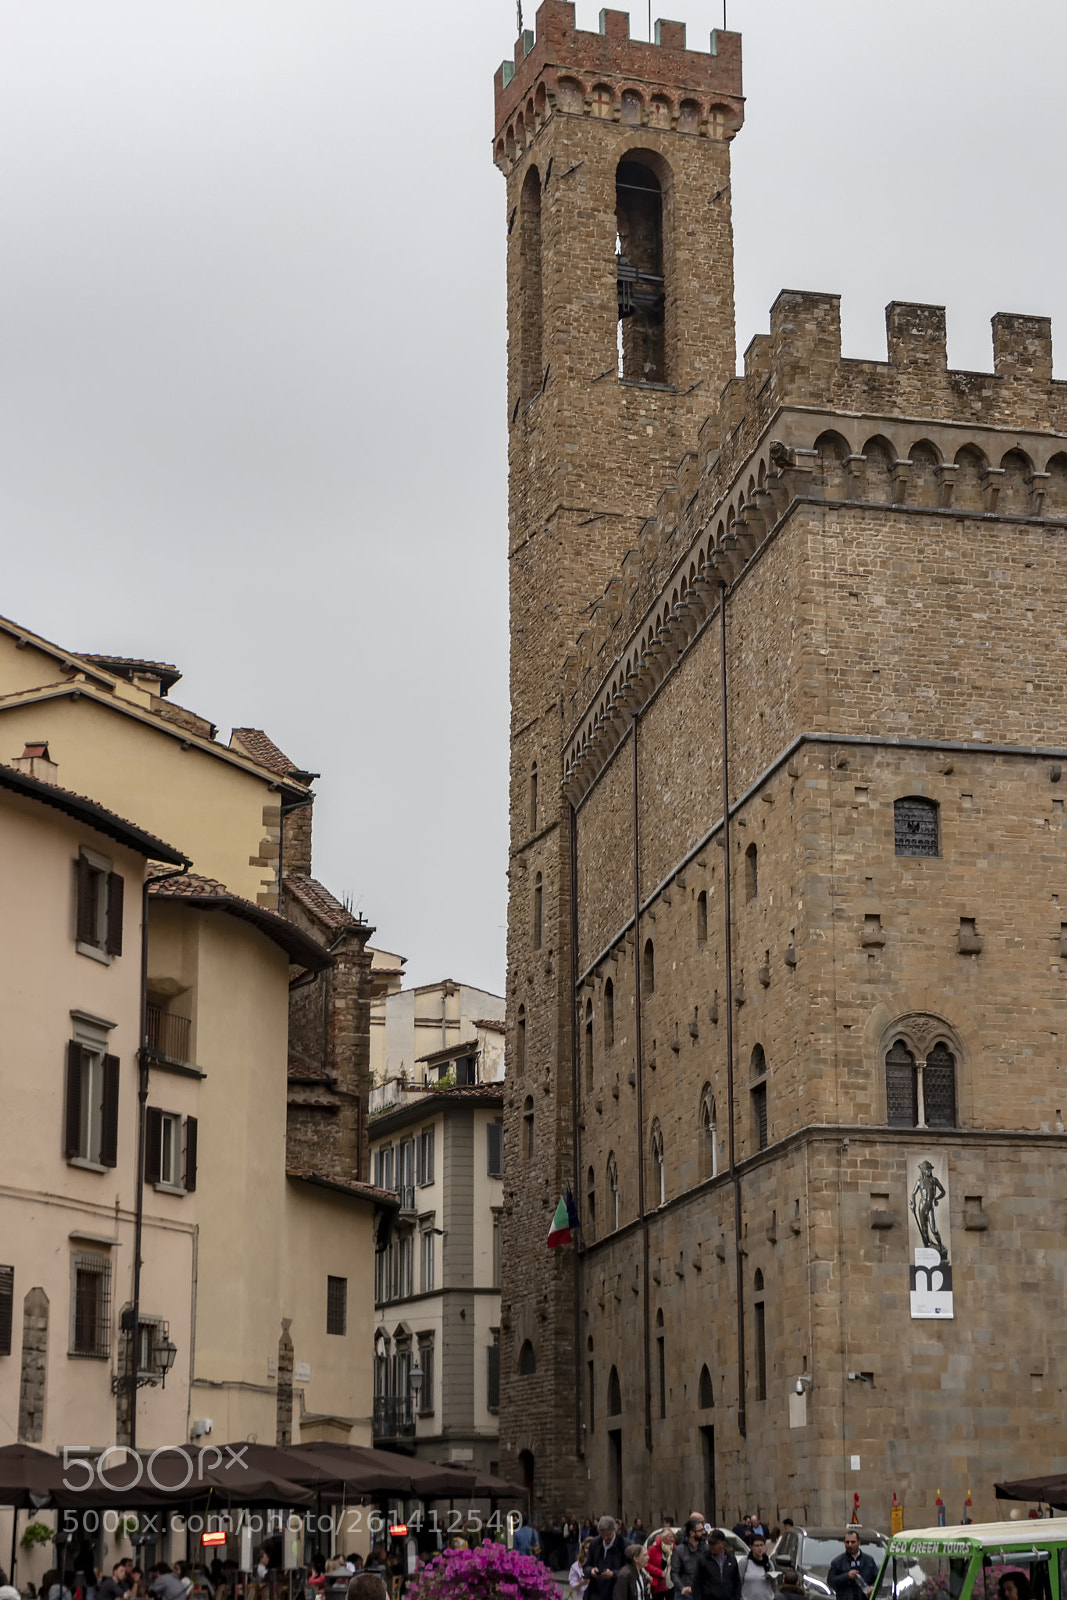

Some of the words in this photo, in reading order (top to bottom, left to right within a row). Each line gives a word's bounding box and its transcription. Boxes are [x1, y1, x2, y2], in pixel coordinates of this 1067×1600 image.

[889, 1542, 907, 1553] ECO
[910, 1542, 939, 1554] GREEN
[942, 1542, 971, 1554] TOURS
